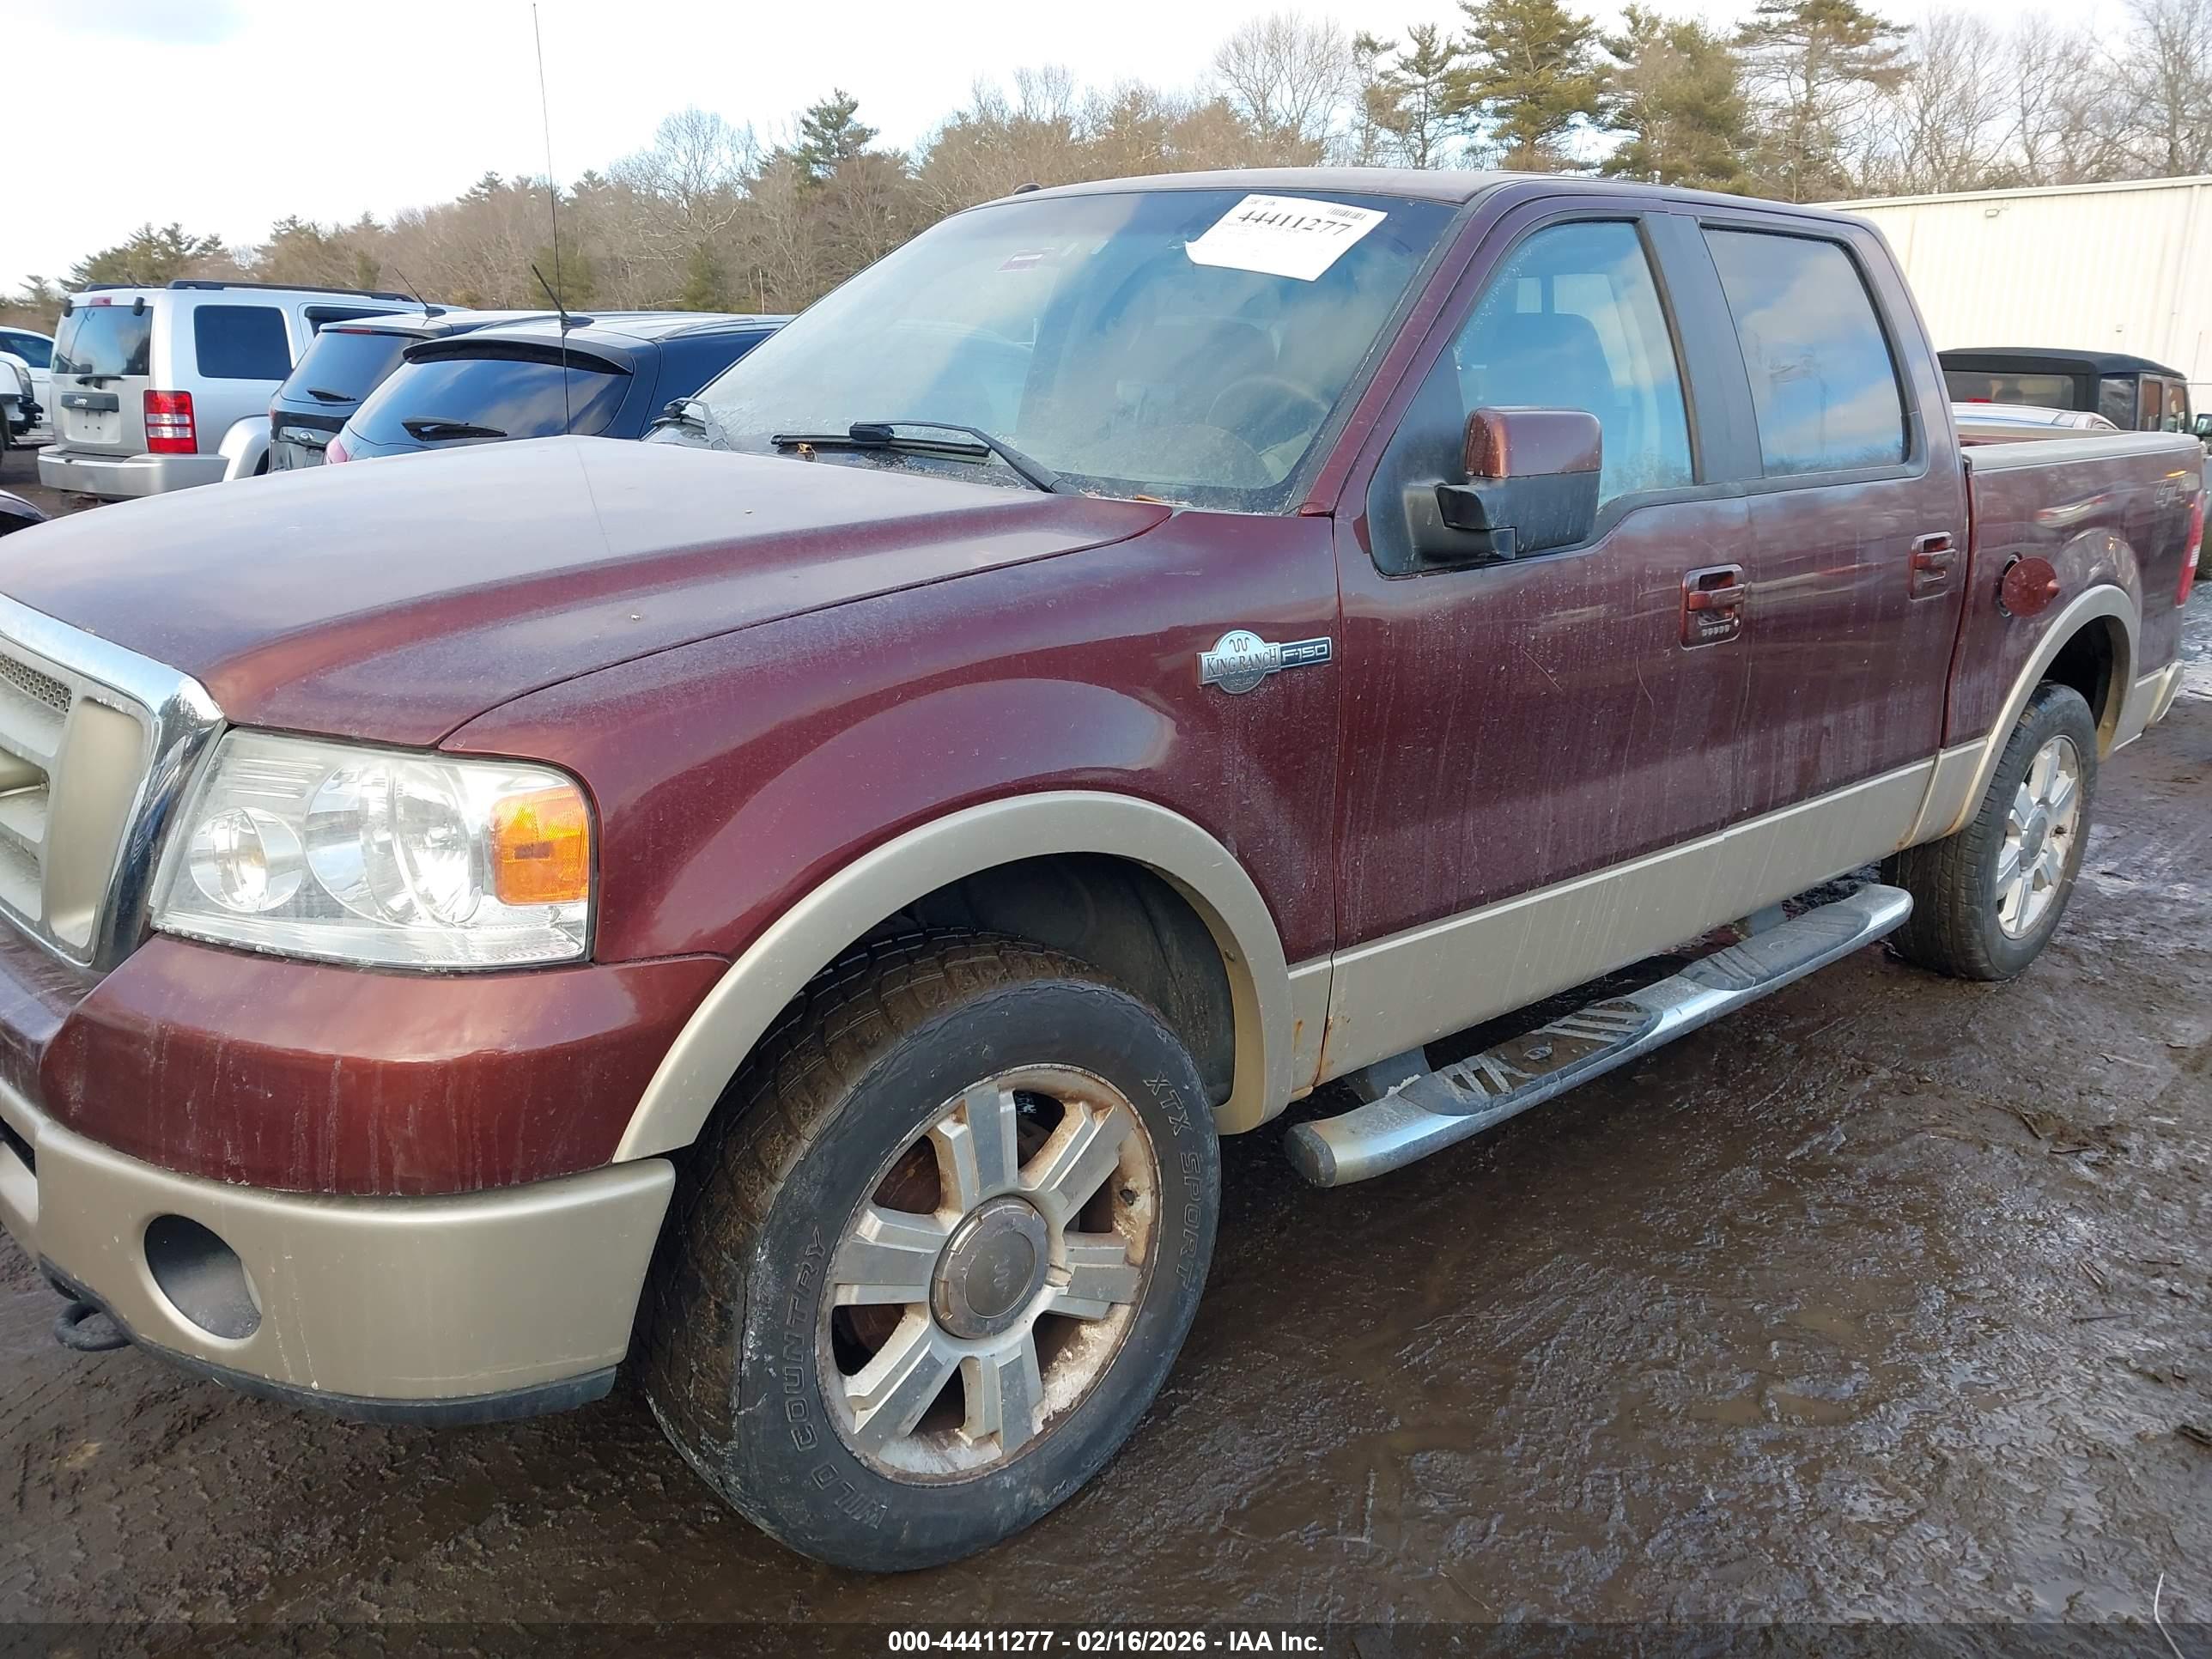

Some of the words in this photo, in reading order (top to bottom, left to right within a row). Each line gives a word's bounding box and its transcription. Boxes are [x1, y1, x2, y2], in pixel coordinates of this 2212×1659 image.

[1238, 210, 1353, 235] 44411277
[1206, 656, 1236, 677] KING
[1238, 648, 1277, 672] RANCH
[1281, 644, 1328, 662] F-150
[1143, 1073, 1194, 1137] XTX
[1176, 1152, 1202, 1290] SPORT
[782, 1226, 826, 1453] COUNTRY
[811, 1462, 888, 1530] WILD
